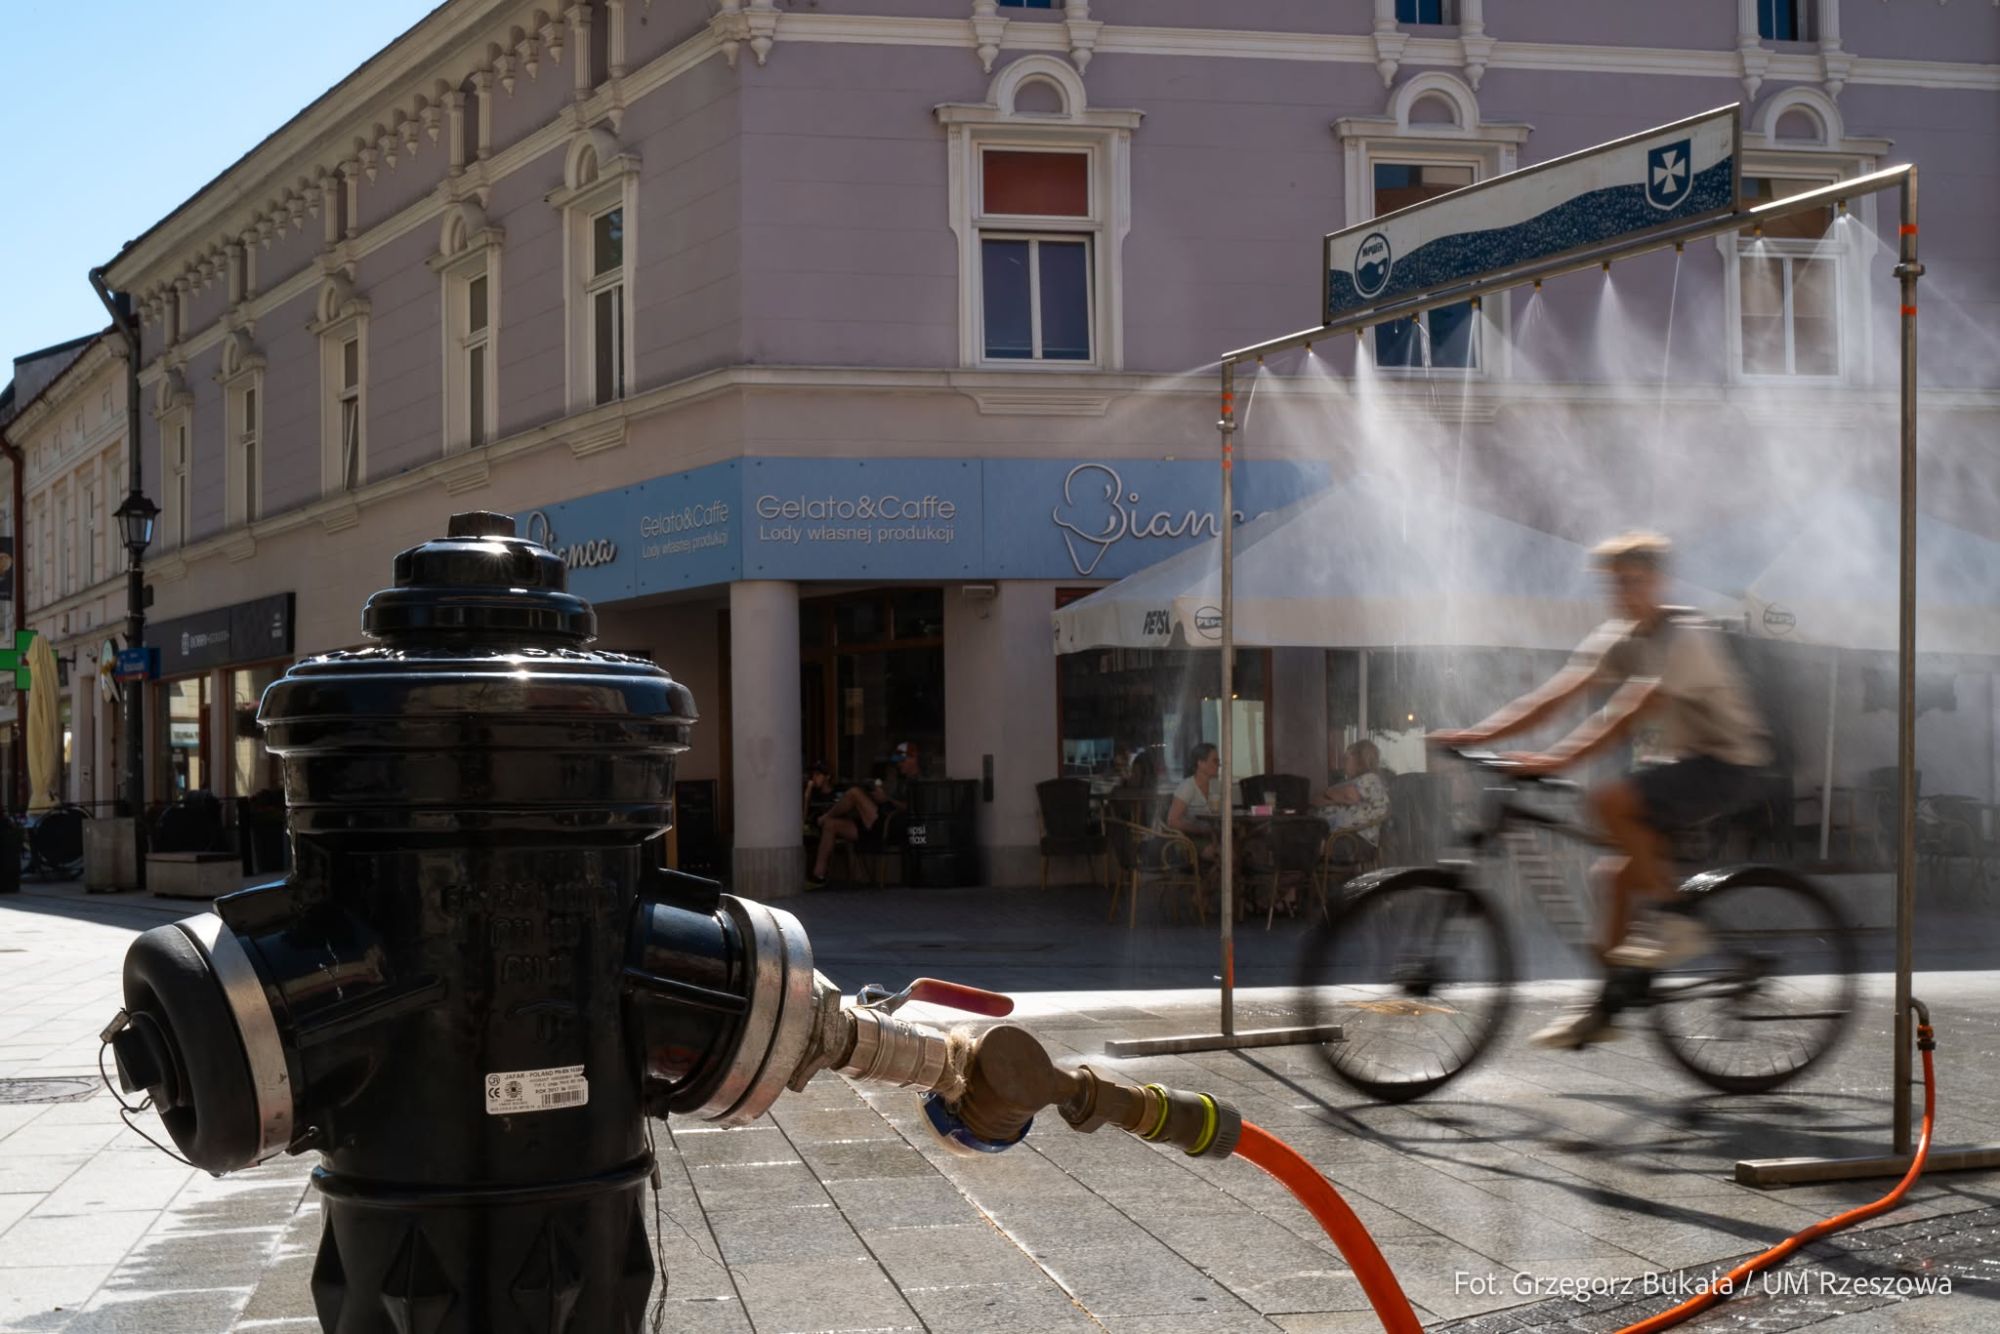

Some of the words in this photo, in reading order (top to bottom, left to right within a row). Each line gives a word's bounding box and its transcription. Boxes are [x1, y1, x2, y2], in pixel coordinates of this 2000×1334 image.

[755, 494, 957, 520] Gelato&Caffe
[1053, 463, 1277, 543] Bian
[640, 500, 729, 538] Gelato&Caffe
[759, 525, 801, 544] Lody
[808, 525, 872, 544] własnej
[878, 525, 954, 543] produkcji
[642, 543, 660, 560] Lody
[529, 1070, 554, 1078] POLAND
